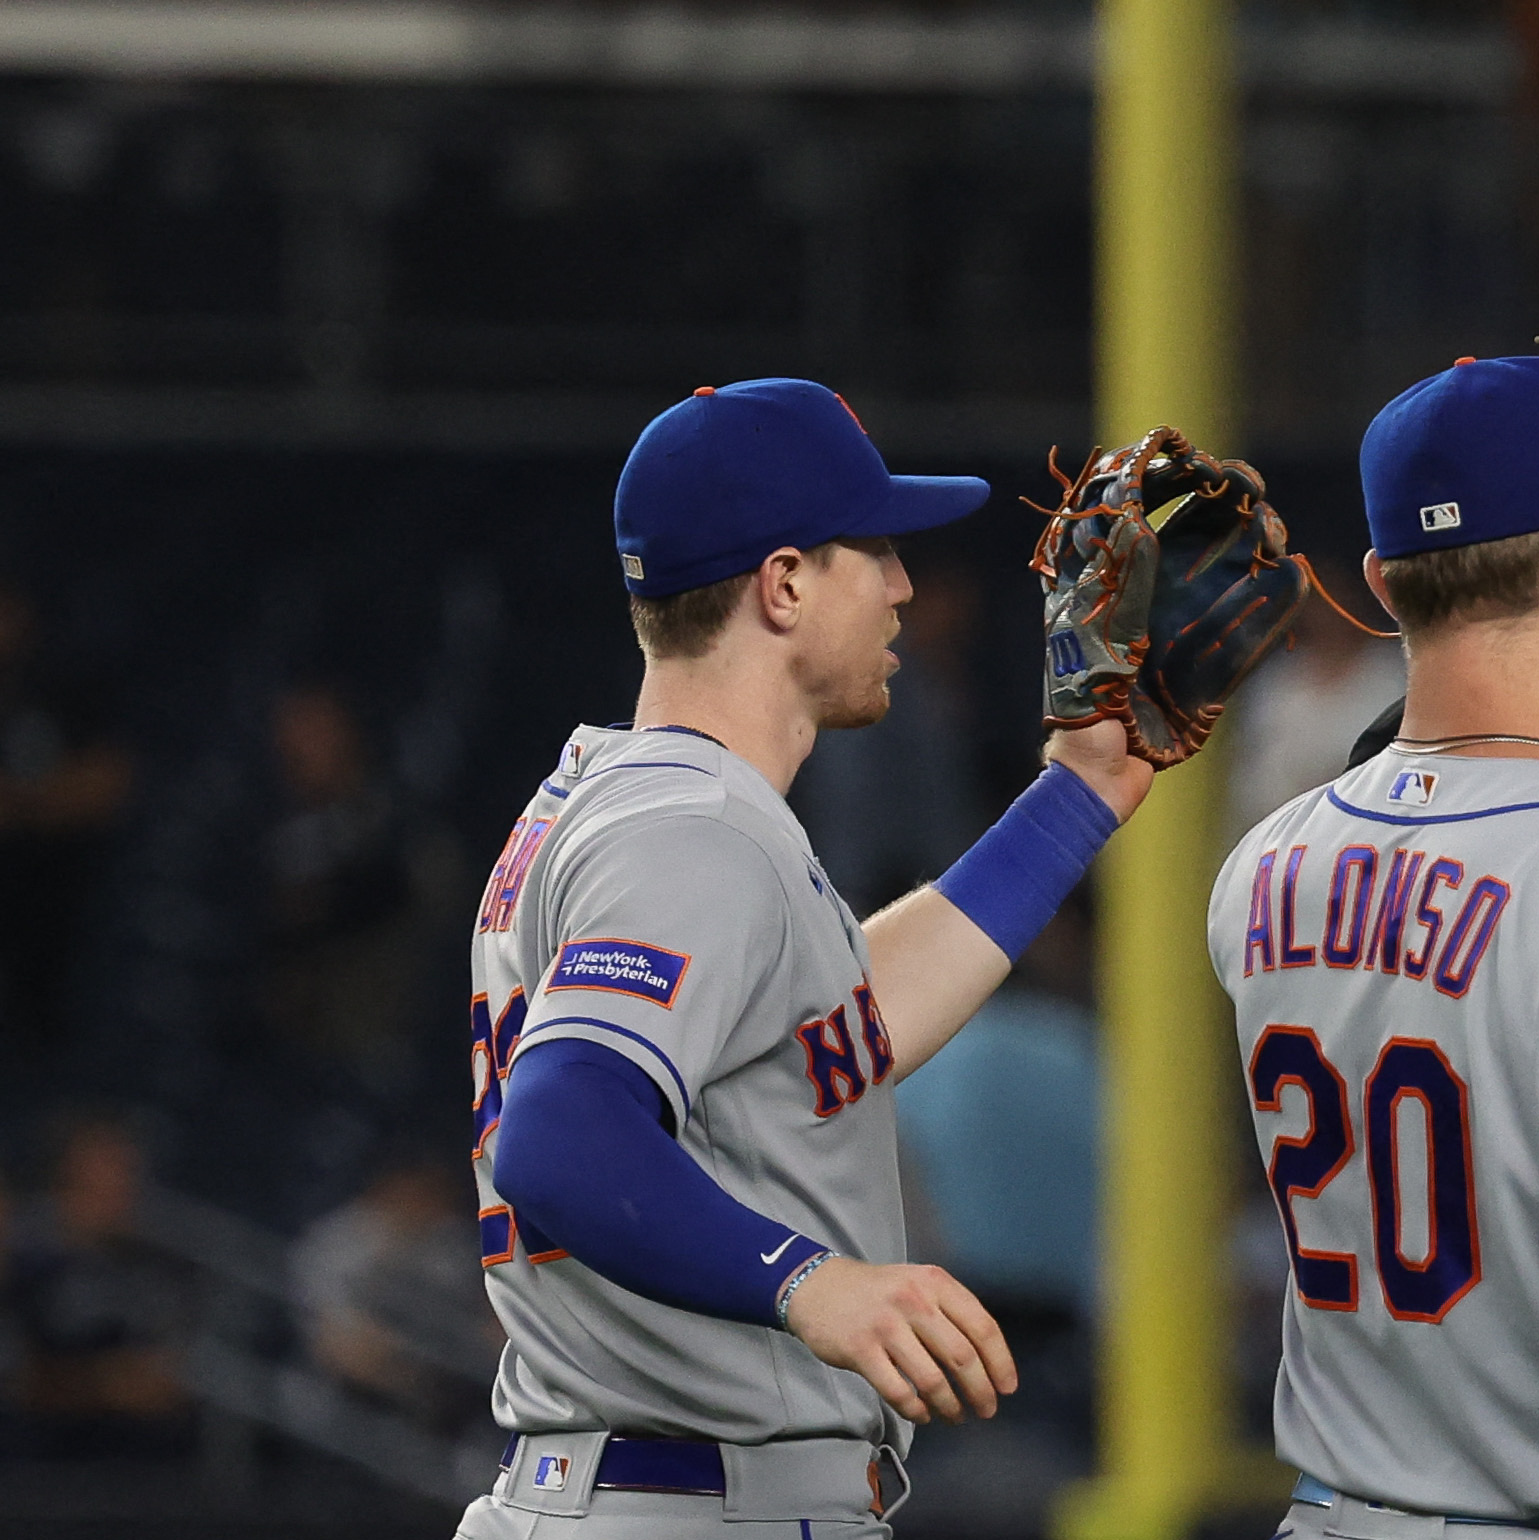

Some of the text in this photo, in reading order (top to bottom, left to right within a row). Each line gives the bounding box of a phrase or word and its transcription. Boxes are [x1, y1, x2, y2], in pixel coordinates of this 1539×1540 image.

[573, 963, 669, 990] Presbyterian
[1243, 844, 1511, 999] ALONSO
[1250, 1024, 1481, 1324] 20
